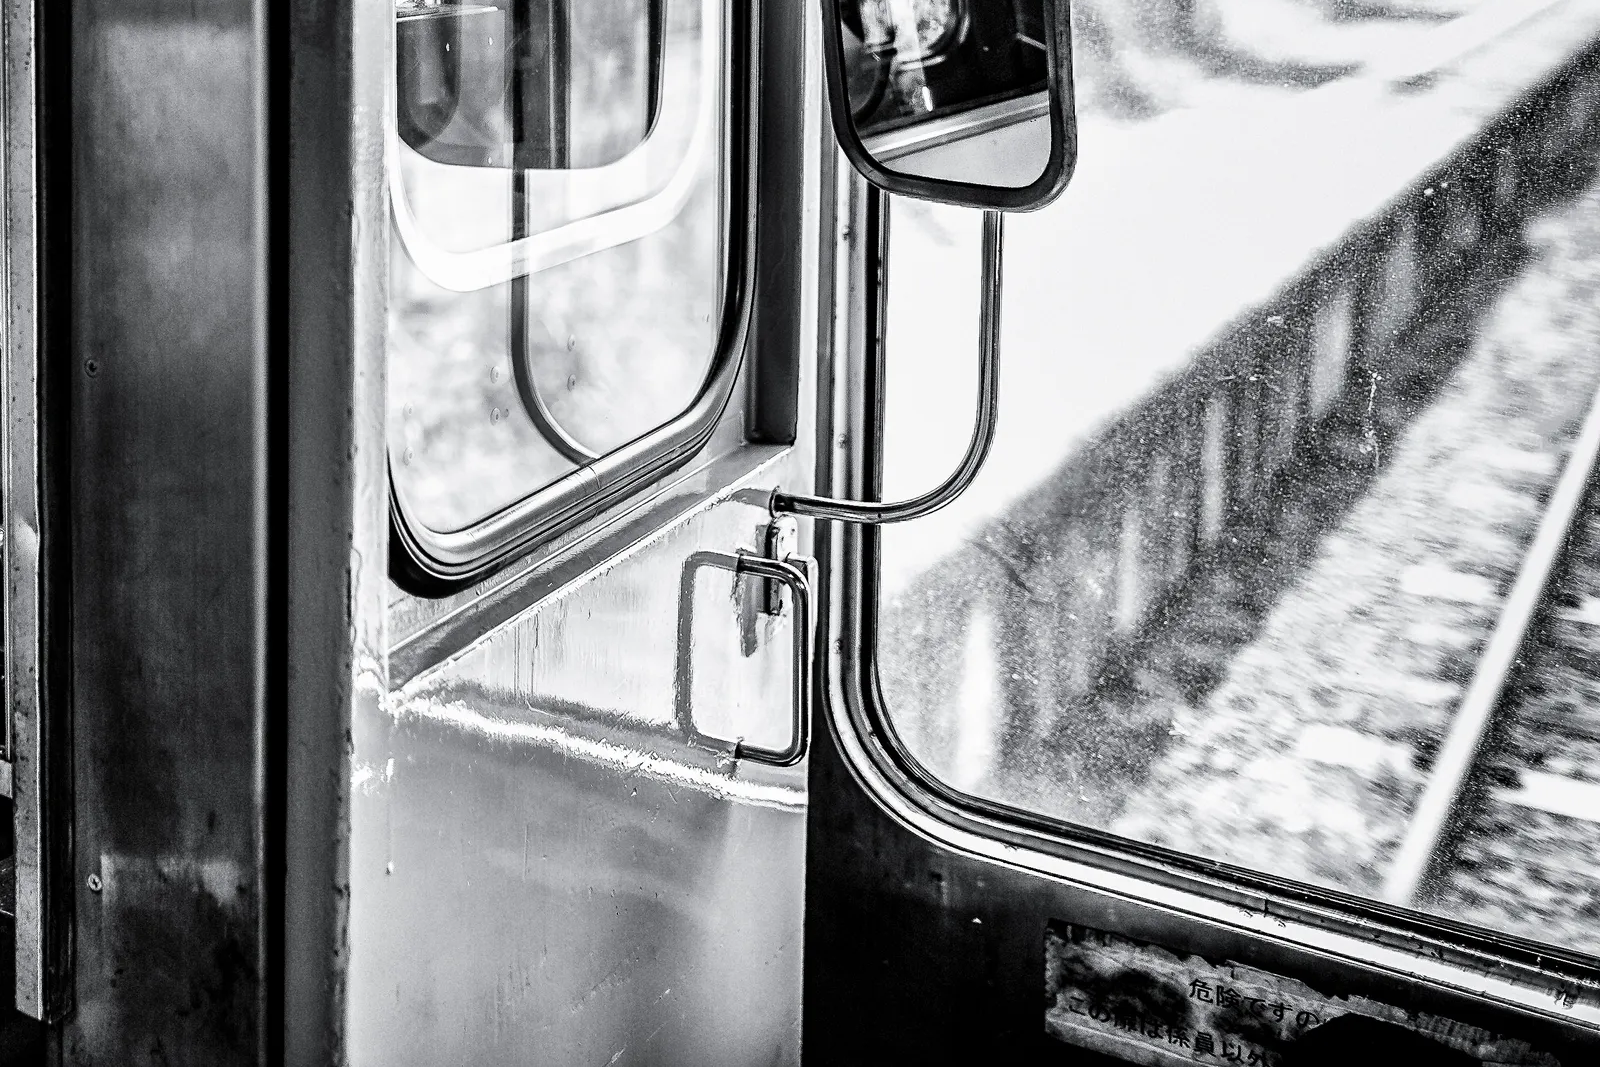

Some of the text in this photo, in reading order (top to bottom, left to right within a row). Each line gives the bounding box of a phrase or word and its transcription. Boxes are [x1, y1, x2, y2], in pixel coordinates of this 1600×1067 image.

[1189, 977, 1328, 1029] 危険ですの
